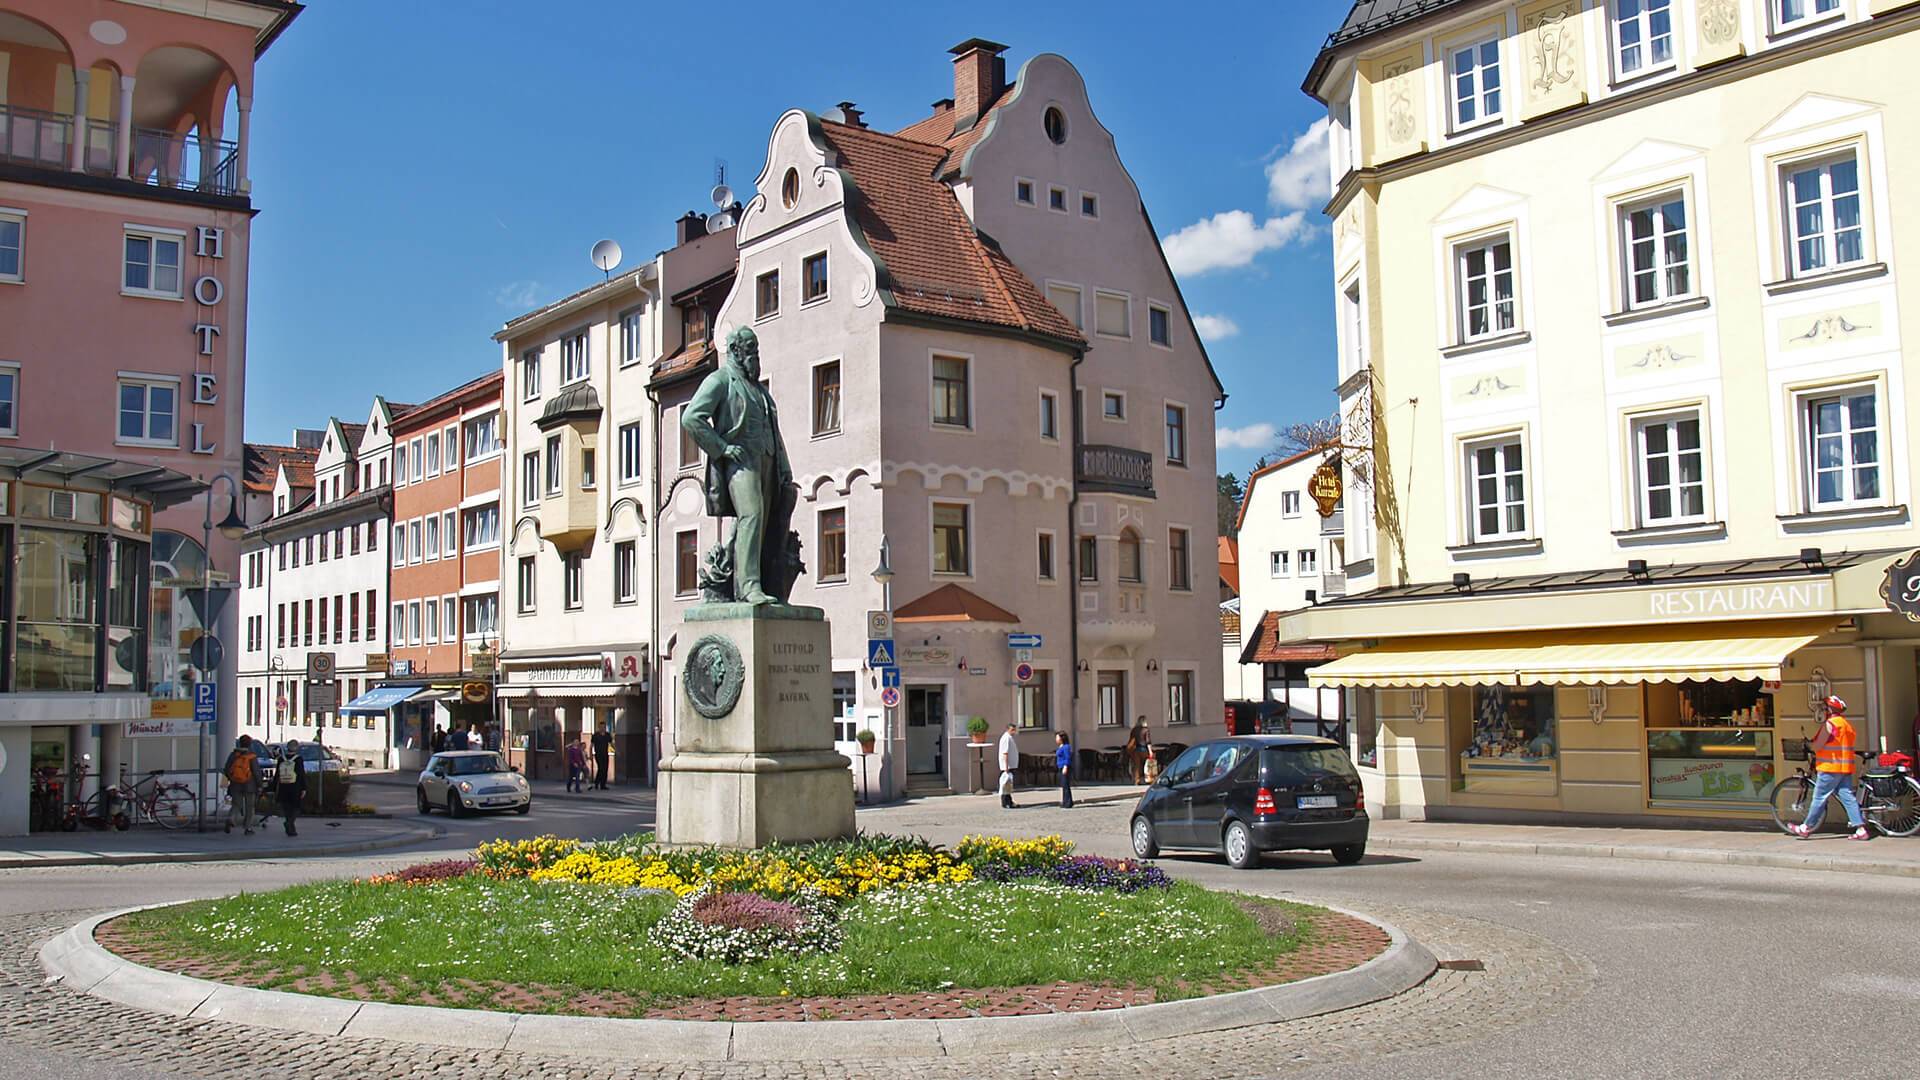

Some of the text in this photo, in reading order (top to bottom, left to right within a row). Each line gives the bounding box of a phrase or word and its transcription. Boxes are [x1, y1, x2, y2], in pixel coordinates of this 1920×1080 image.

[191, 226, 224, 455] HOTEL
[1650, 583, 1828, 615] RESTAURANT
[875, 617, 886, 626] 30
[772, 642, 814, 655] LUITPOLD
[317, 659, 328, 668] 30
[619, 655, 639, 679] A
[528, 666, 570, 681] BAHNHOF
[199, 685, 211, 704] P
[128, 721, 163, 735] Münzel
[1699, 770, 1745, 797] Eis
